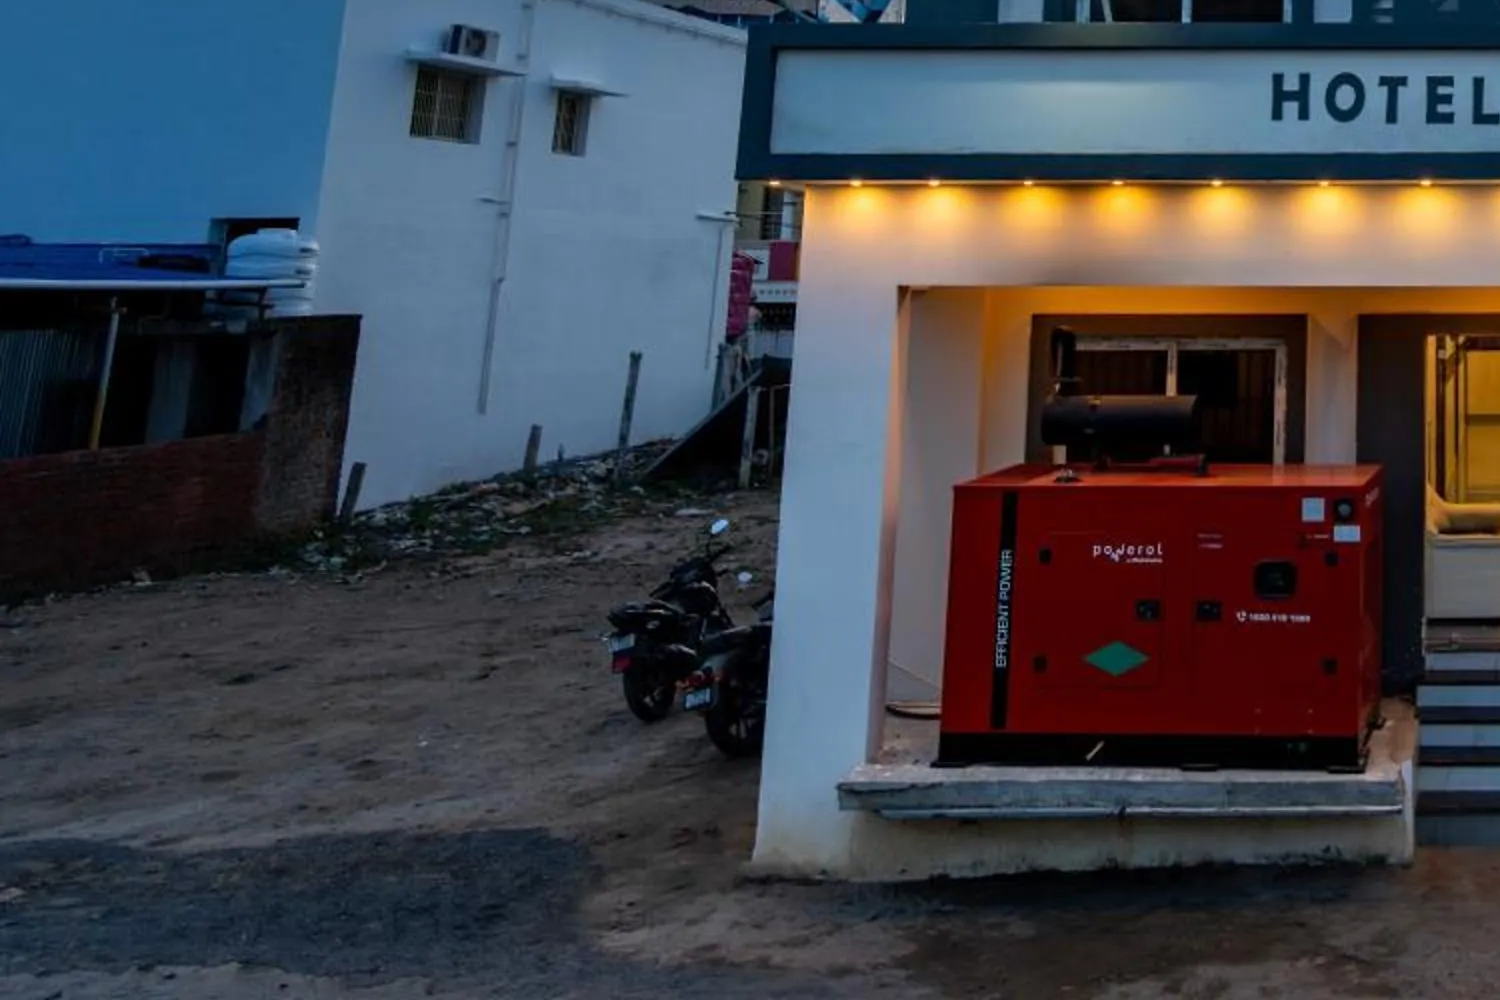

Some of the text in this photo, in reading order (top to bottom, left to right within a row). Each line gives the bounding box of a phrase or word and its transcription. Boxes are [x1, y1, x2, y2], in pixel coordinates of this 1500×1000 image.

[1271, 72, 1500, 125] HOTEL
[995, 548, 1013, 668] EFFICIENT POWER
